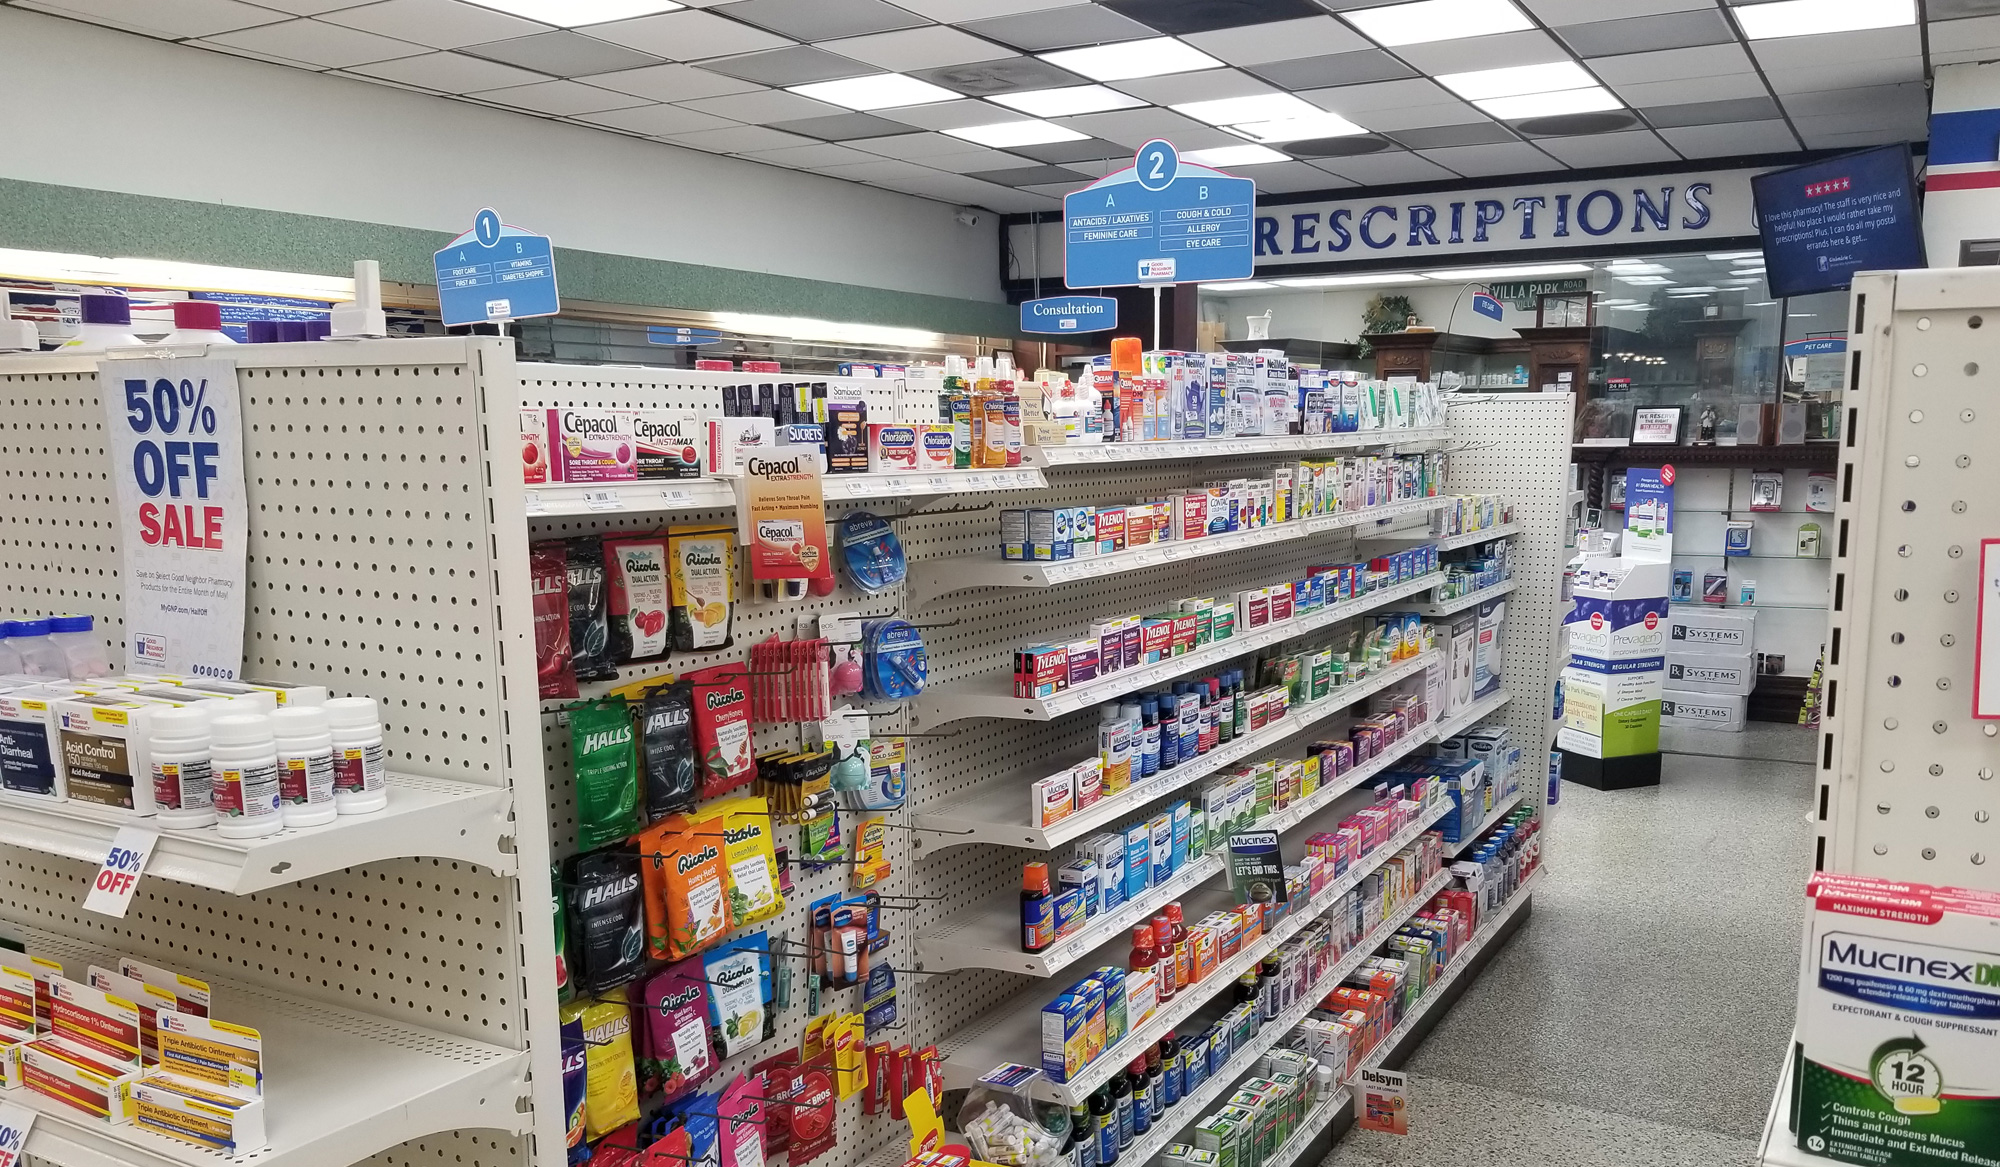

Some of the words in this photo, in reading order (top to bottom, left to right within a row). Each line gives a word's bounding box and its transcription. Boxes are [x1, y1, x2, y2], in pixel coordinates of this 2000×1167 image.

[1150, 151, 1164, 179] 2
[1106, 194, 1115, 207] A
[1200, 186, 1208, 199] B
[1769, 212, 1780, 222] love
[1781, 209, 1792, 220] this
[1793, 204, 1823, 220] pharmacy!
[1824, 202, 1835, 211] The
[1837, 199, 1851, 209] staff
[1851, 197, 1857, 206] is
[1858, 196, 1872, 206] very
[1873, 192, 1887, 201] nice
[1888, 188, 1901, 198] and
[1073, 217, 1107, 227] ANTACIDS
[1112, 214, 1149, 223] LAXATIVES
[1177, 210, 1202, 218] COUGH
[1255, 181, 1713, 256] RESCRIPTIONS
[1774, 220, 1796, 233] helpful!
[1797, 218, 1806, 228] No
[1807, 215, 1822, 228] place
[1827, 212, 1846, 222] would
[1847, 209, 1866, 220] rather
[1867, 205, 1882, 215] take
[1883, 204, 1893, 214] my
[483, 217, 491, 238] 1
[1084, 231, 1117, 240] FEMININE
[1119, 229, 1137, 238] CARE
[1187, 223, 1220, 233] ALLERGY
[1775, 229, 1814, 246] prescriptions!
[1815, 227, 1829, 237] Plus,
[1834, 224, 1845, 233] can
[1846, 222, 1855, 232] do
[1865, 220, 1875, 230] my
[1876, 215, 1896, 228] postal
[516, 242, 522, 253] B
[1187, 240, 1200, 248] EYE
[1202, 238, 1221, 246] CARE
[1806, 238, 1829, 250] errands
[1830, 237, 1844, 247] here
[1845, 236, 1850, 244] &
[460, 251, 466, 262] A
[510, 260, 532, 268] VITAMINS
[502, 272, 525, 281] DIABETES
[525, 270, 544, 278] SHOPPE
[1493, 285, 1525, 299] VILLA
[1530, 283, 1559, 298] PARK
[1033, 303, 1103, 316] Consultation
[1267, 359, 1286, 370] NeilMed
[833, 386, 862, 396] Sambucol
[124, 378, 216, 435] 50%
[564, 412, 617, 438] Cēpacol
[789, 427, 823, 441] SUCRETS
[880, 433, 915, 444] Chloraseptic
[133, 440, 220, 500] OFF
[749, 457, 799, 480] Cēpacol
[139, 502, 224, 550] SALE
[1098, 512, 1124, 525] TYLENOL
[626, 559, 660, 573] Ricola
[686, 552, 721, 566] Ricola
[136, 570, 147, 578] Save
[156, 572, 170, 580] Select
[171, 573, 184, 581] Good
[185, 574, 207, 585] Neighbor
[208, 577, 233, 588] Pharmacy
[141, 582, 161, 592] Products
[170, 585, 178, 593] the
[179, 586, 192, 595] Entire
[194, 588, 209, 596] Month
[217, 591, 228, 600] May!
[887, 630, 908, 639] abreva
[1145, 625, 1170, 641] TYLENOL
[1689, 629, 1738, 640] SYSTEMS
[1037, 653, 1066, 672] TYLENOL
[1612, 662, 1636, 670] REGULAR
[1637, 661, 1660, 669] STRENGTH
[1687, 669, 1736, 679] SYSTEMS
[707, 688, 745, 710] Ricola
[1678, 706, 1727, 717] SYSTEMS
[582, 724, 632, 755] HALLS
[0, 745, 33, 759] Diarrheal
[66, 741, 83, 754] Acid
[85, 745, 116, 759] Control
[67, 753, 80, 765] 150
[72, 768, 81, 776] Acid
[81, 770, 101, 779] Reducer
[1232, 837, 1275, 845] Mucinex
[106, 847, 144, 873] 50%
[678, 846, 717, 874] Ricola
[1236, 866, 1251, 875] LET'S
[1252, 866, 1263, 874] END
[1263, 865, 1279, 874] THIS.
[97, 870, 136, 895] OFF
[584, 873, 638, 908] HALLS
[1833, 903, 1878, 916] MAXIMUM
[1880, 909, 1929, 923] STRENGTH
[717, 964, 754, 983] Ricola
[1826, 973, 1843, 982] 1200
[1844, 978, 1855, 986] mg
[1856, 978, 1897, 991] guaifenesin
[1905, 986, 1914, 994] 60
[1916, 989, 1927, 997] mg
[1929, 989, 1996, 1006] dextromethorphan
[53, 1002, 90, 1023] Hydrocortisone
[91, 1016, 100, 1027] 1%
[100, 1020, 124, 1036] Ointment
[1832, 1003, 1892, 1020] EXPECTORANT
[1903, 1015, 1933, 1027] COUGH
[1935, 1020, 1998, 1037] SUPPRESSANT
[163, 1035, 179, 1046] Triple
[180, 1040, 207, 1052] Antibiotic
[209, 1047, 236, 1059] Ointment
[1362, 1070, 1402, 1086] Delsym
[1891, 1061, 1926, 1084] 12
[1891, 1081, 1924, 1095] HOUR
[137, 1102, 152, 1112] Triple
[154, 1107, 180, 1121] Antibiotic
[182, 1115, 208, 1129] Ointment
[1833, 1102, 1876, 1119] Controls
[1878, 1111, 1911, 1126] Cough
[1833, 1114, 1860, 1129] Thins
[1863, 1121, 1881, 1133] and
[1884, 1125, 1927, 1142] Loosens
[1929, 1133, 1966, 1149] Mucus
[1809, 1138, 1822, 1149] 14
[1831, 1127, 1885, 1146] Immediate
[1887, 1138, 1906, 1150] and
[1909, 1141, 1958, 1160] Extended
